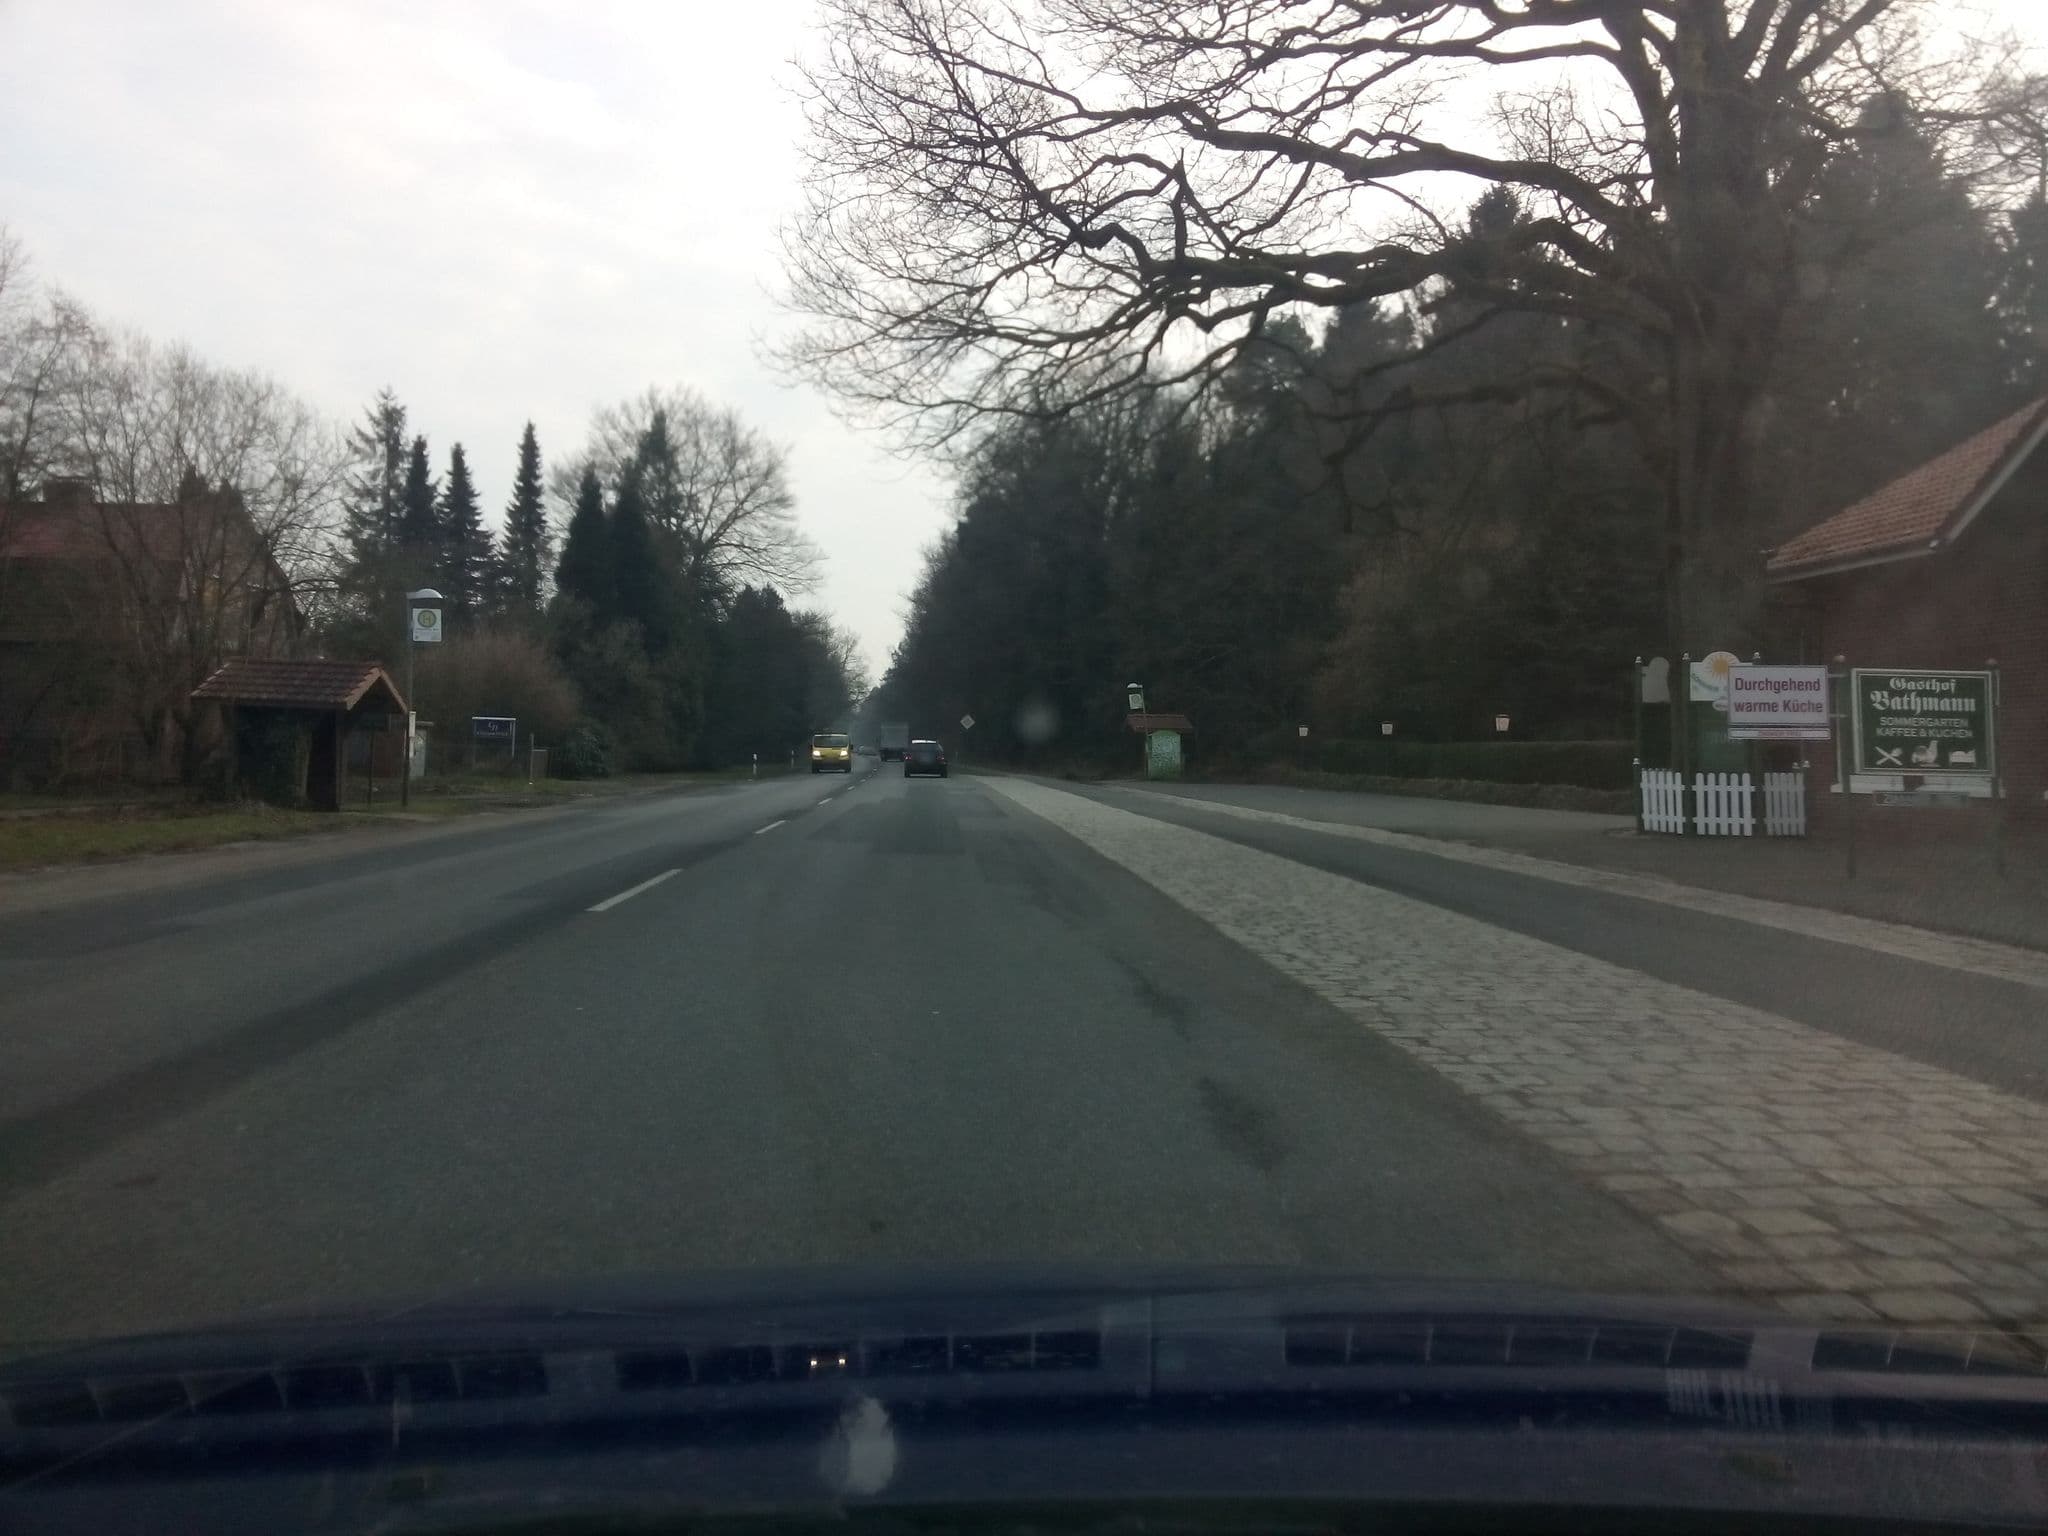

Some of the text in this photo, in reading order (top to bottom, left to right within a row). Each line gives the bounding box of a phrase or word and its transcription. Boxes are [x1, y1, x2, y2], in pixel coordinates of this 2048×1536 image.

[1735, 677, 1821, 693] Durchgehend
[1889, 677, 1957, 694] Gasthof
[1734, 702, 1779, 713] warme
[1783, 699, 1823, 713] Küche
[1879, 716, 1969, 728] SOMMERGARTEN
[1876, 727, 1918, 737] KAFFEE
[1919, 728, 1927, 737] &
